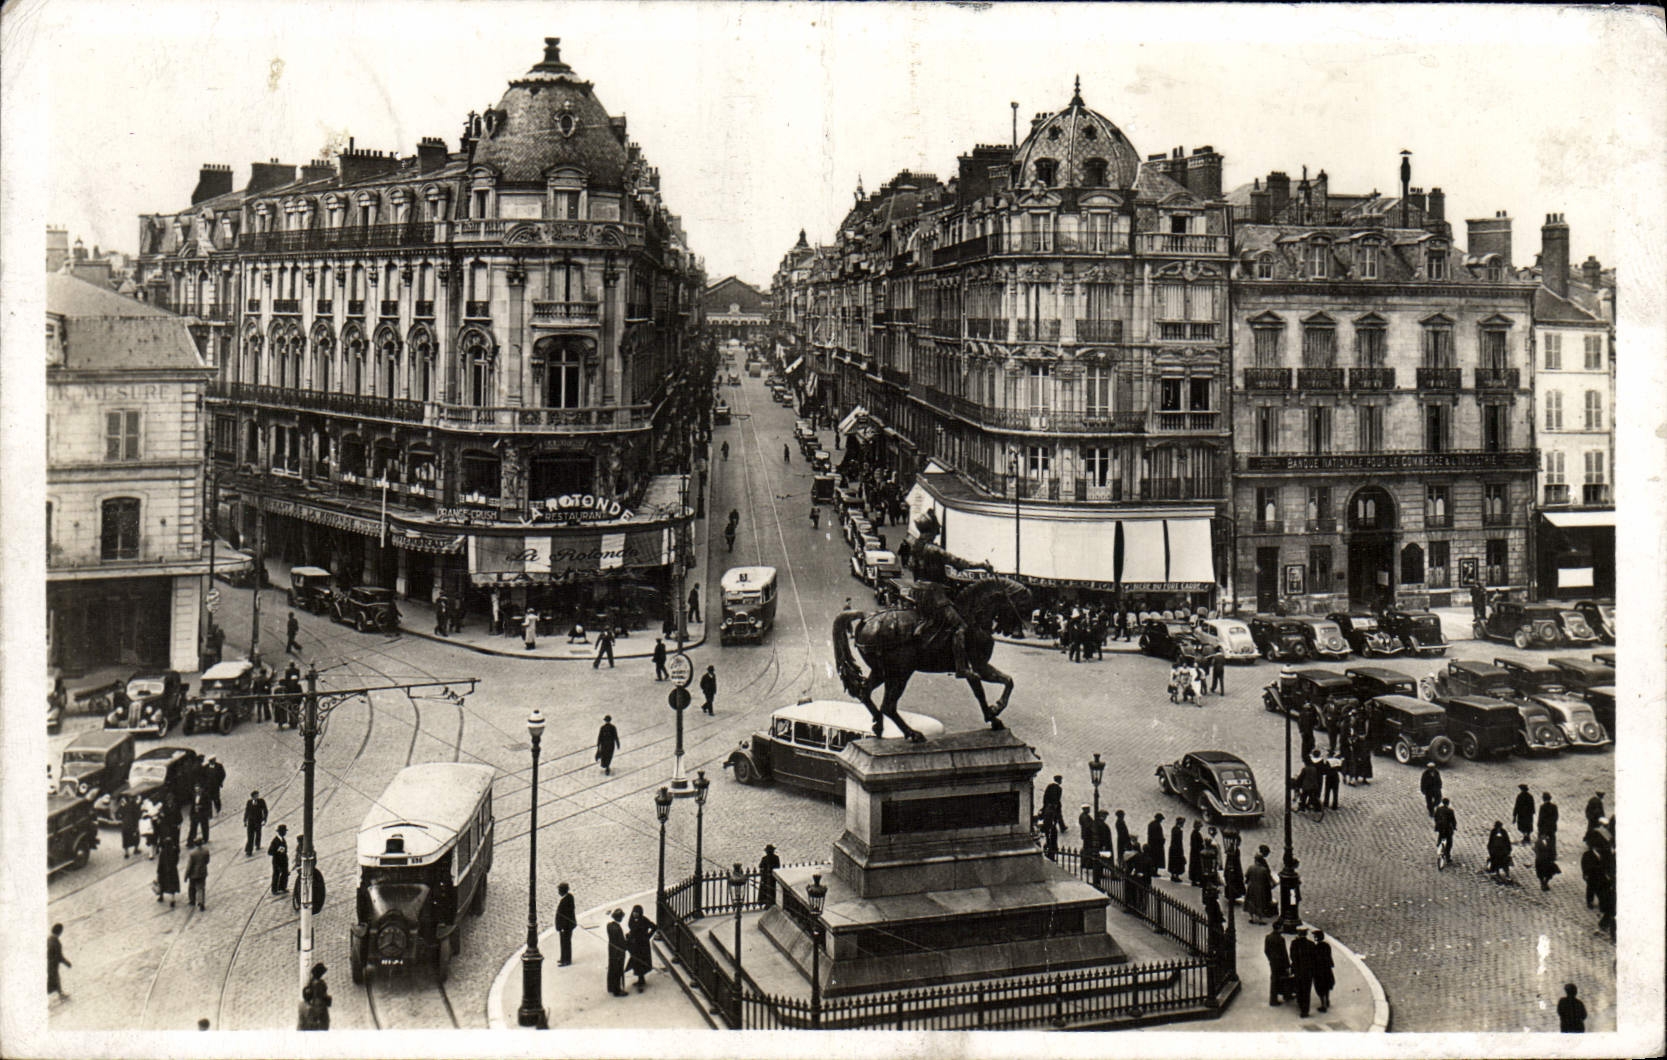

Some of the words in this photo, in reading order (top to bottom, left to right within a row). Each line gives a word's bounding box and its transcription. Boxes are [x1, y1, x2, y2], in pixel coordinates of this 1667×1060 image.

[83, 384, 169, 400] MESURE
[1287, 457, 1318, 468] BANQUE
[1401, 455, 1442, 467] COMMERCE
[518, 506, 543, 525] LA
[545, 493, 633, 522] ROTONDE
[505, 547, 540, 562] La
[549, 546, 639, 562] Rotonde
